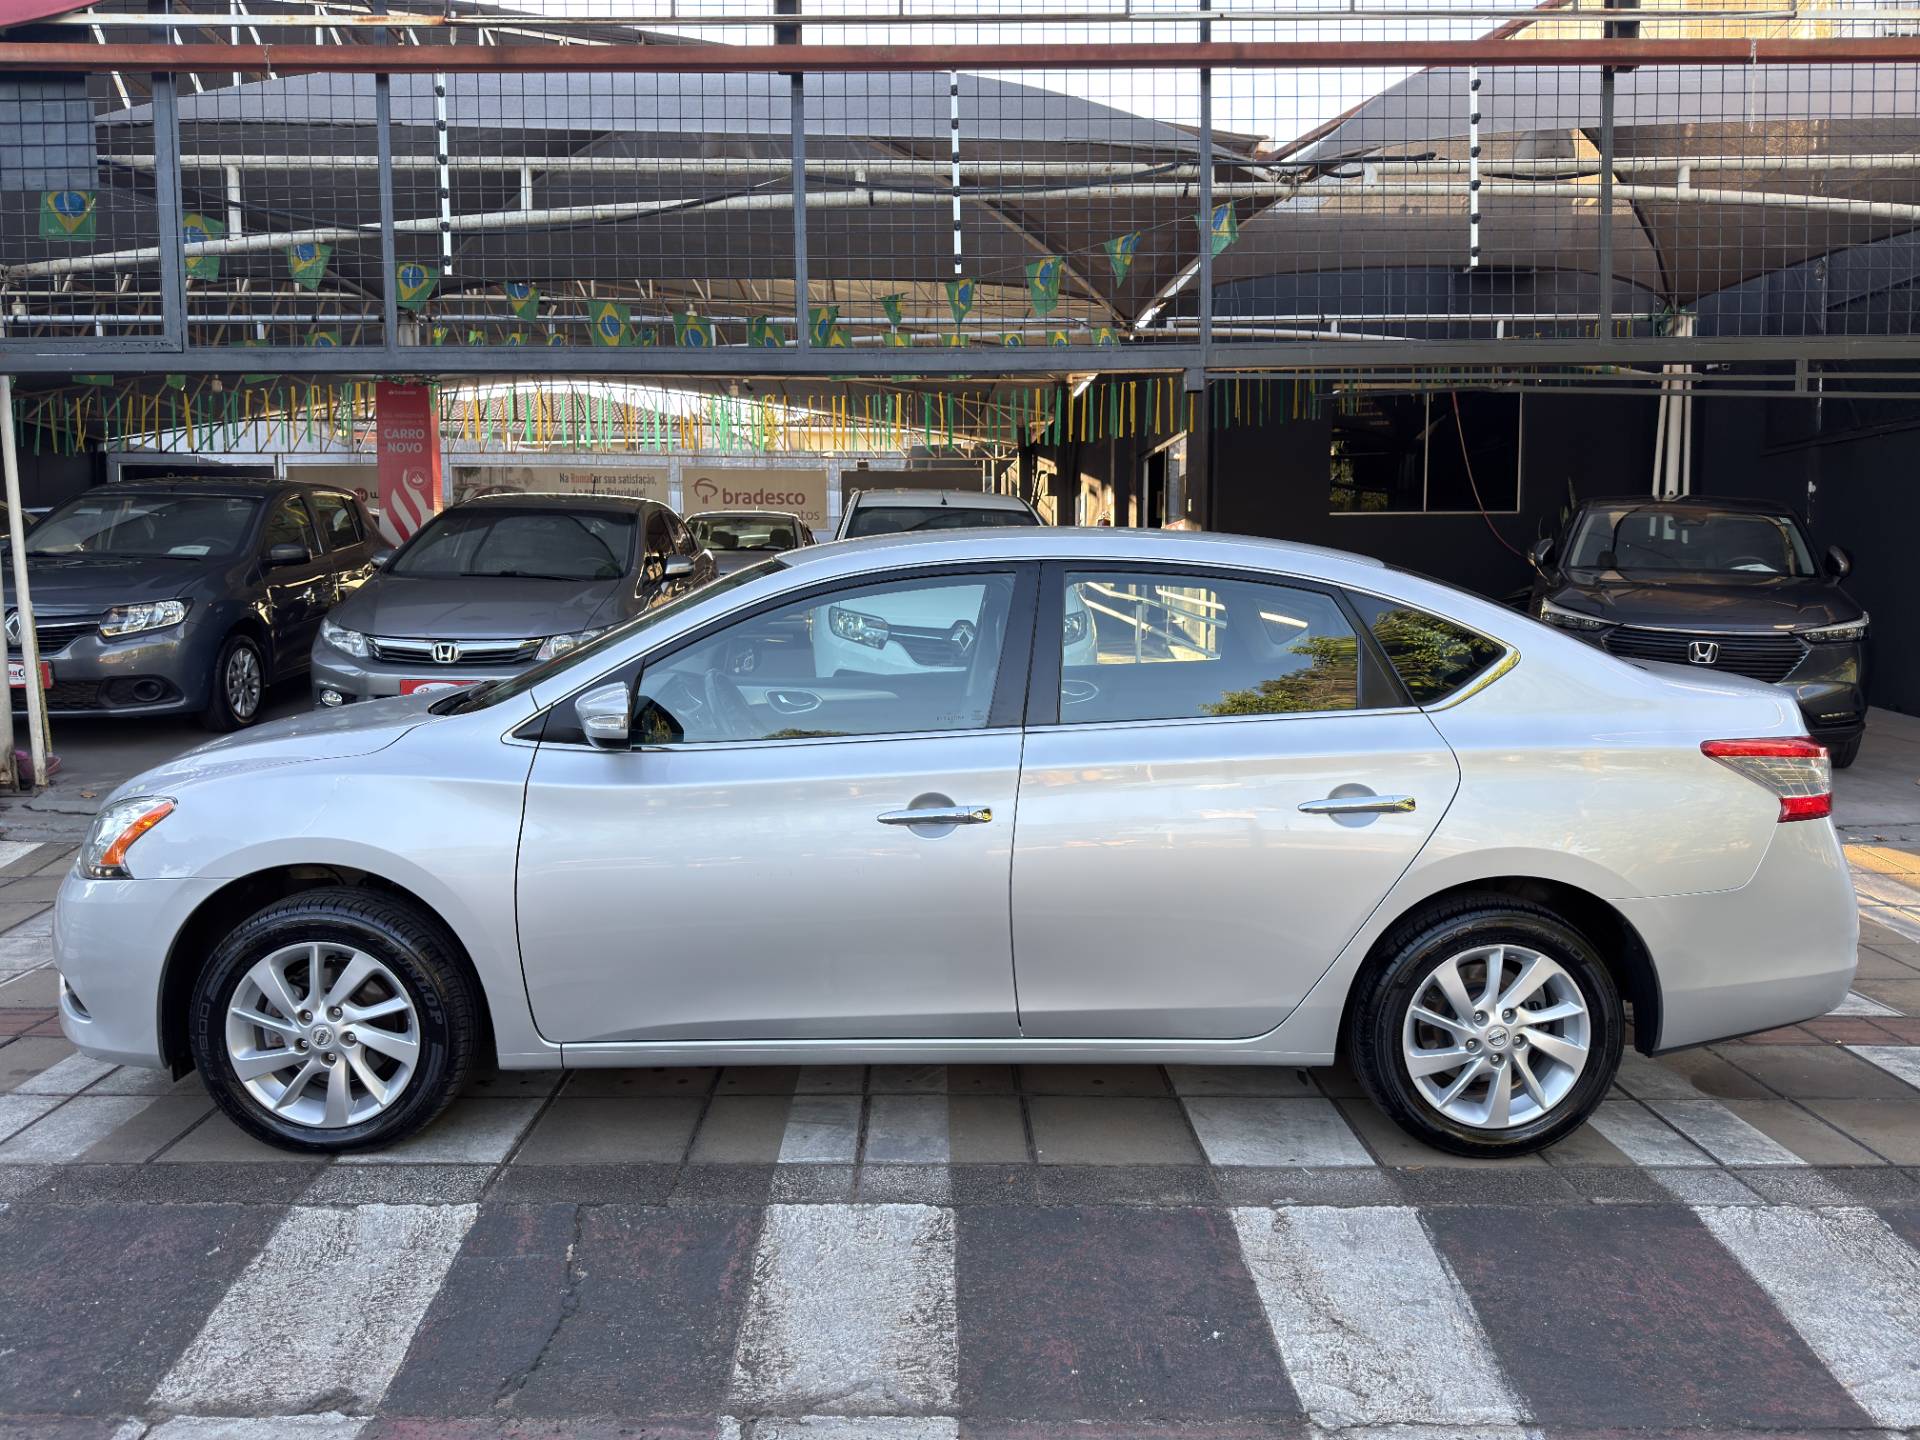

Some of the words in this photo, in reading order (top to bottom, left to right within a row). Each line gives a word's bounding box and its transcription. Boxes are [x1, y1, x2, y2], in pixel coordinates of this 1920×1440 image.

[384, 428, 425, 440] CARRO
[387, 442, 423, 453] NOVO
[560, 472, 569, 483] Na
[722, 488, 806, 505] bradesco
